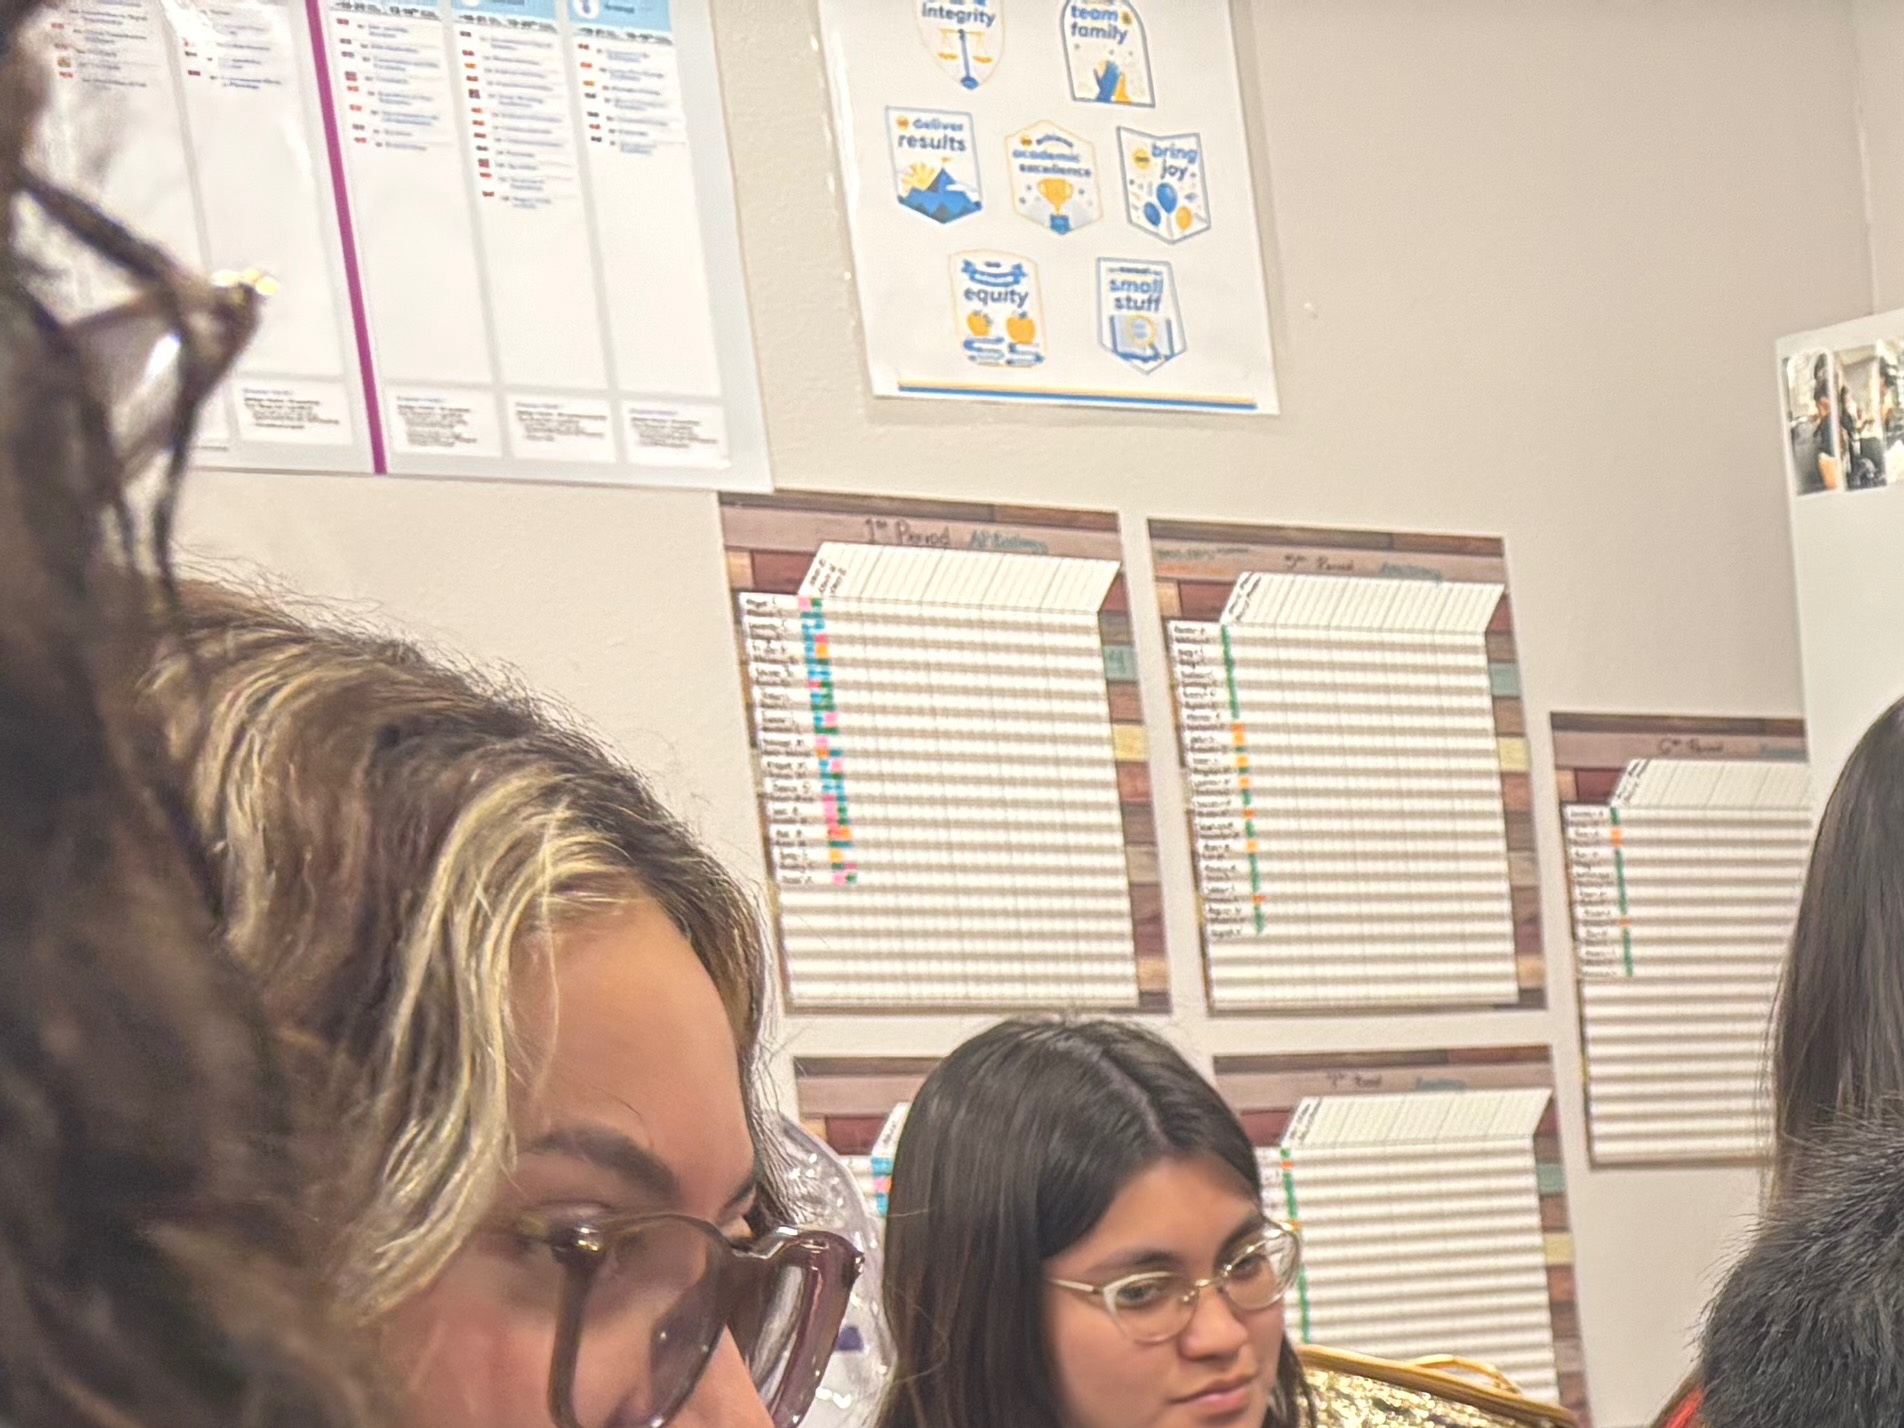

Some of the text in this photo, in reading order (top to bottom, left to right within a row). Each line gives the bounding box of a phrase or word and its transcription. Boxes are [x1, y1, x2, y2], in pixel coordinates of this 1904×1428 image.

[921, 3, 996, 27] integrity
[1071, 5, 1118, 21] team
[1071, 22, 1128, 45] family
[898, 134, 967, 152] results
[1151, 142, 1198, 163] bring
[1161, 160, 1188, 180] joy
[1109, 278, 1164, 293] small
[963, 287, 1029, 308] equity
[1114, 295, 1162, 312] stuff
